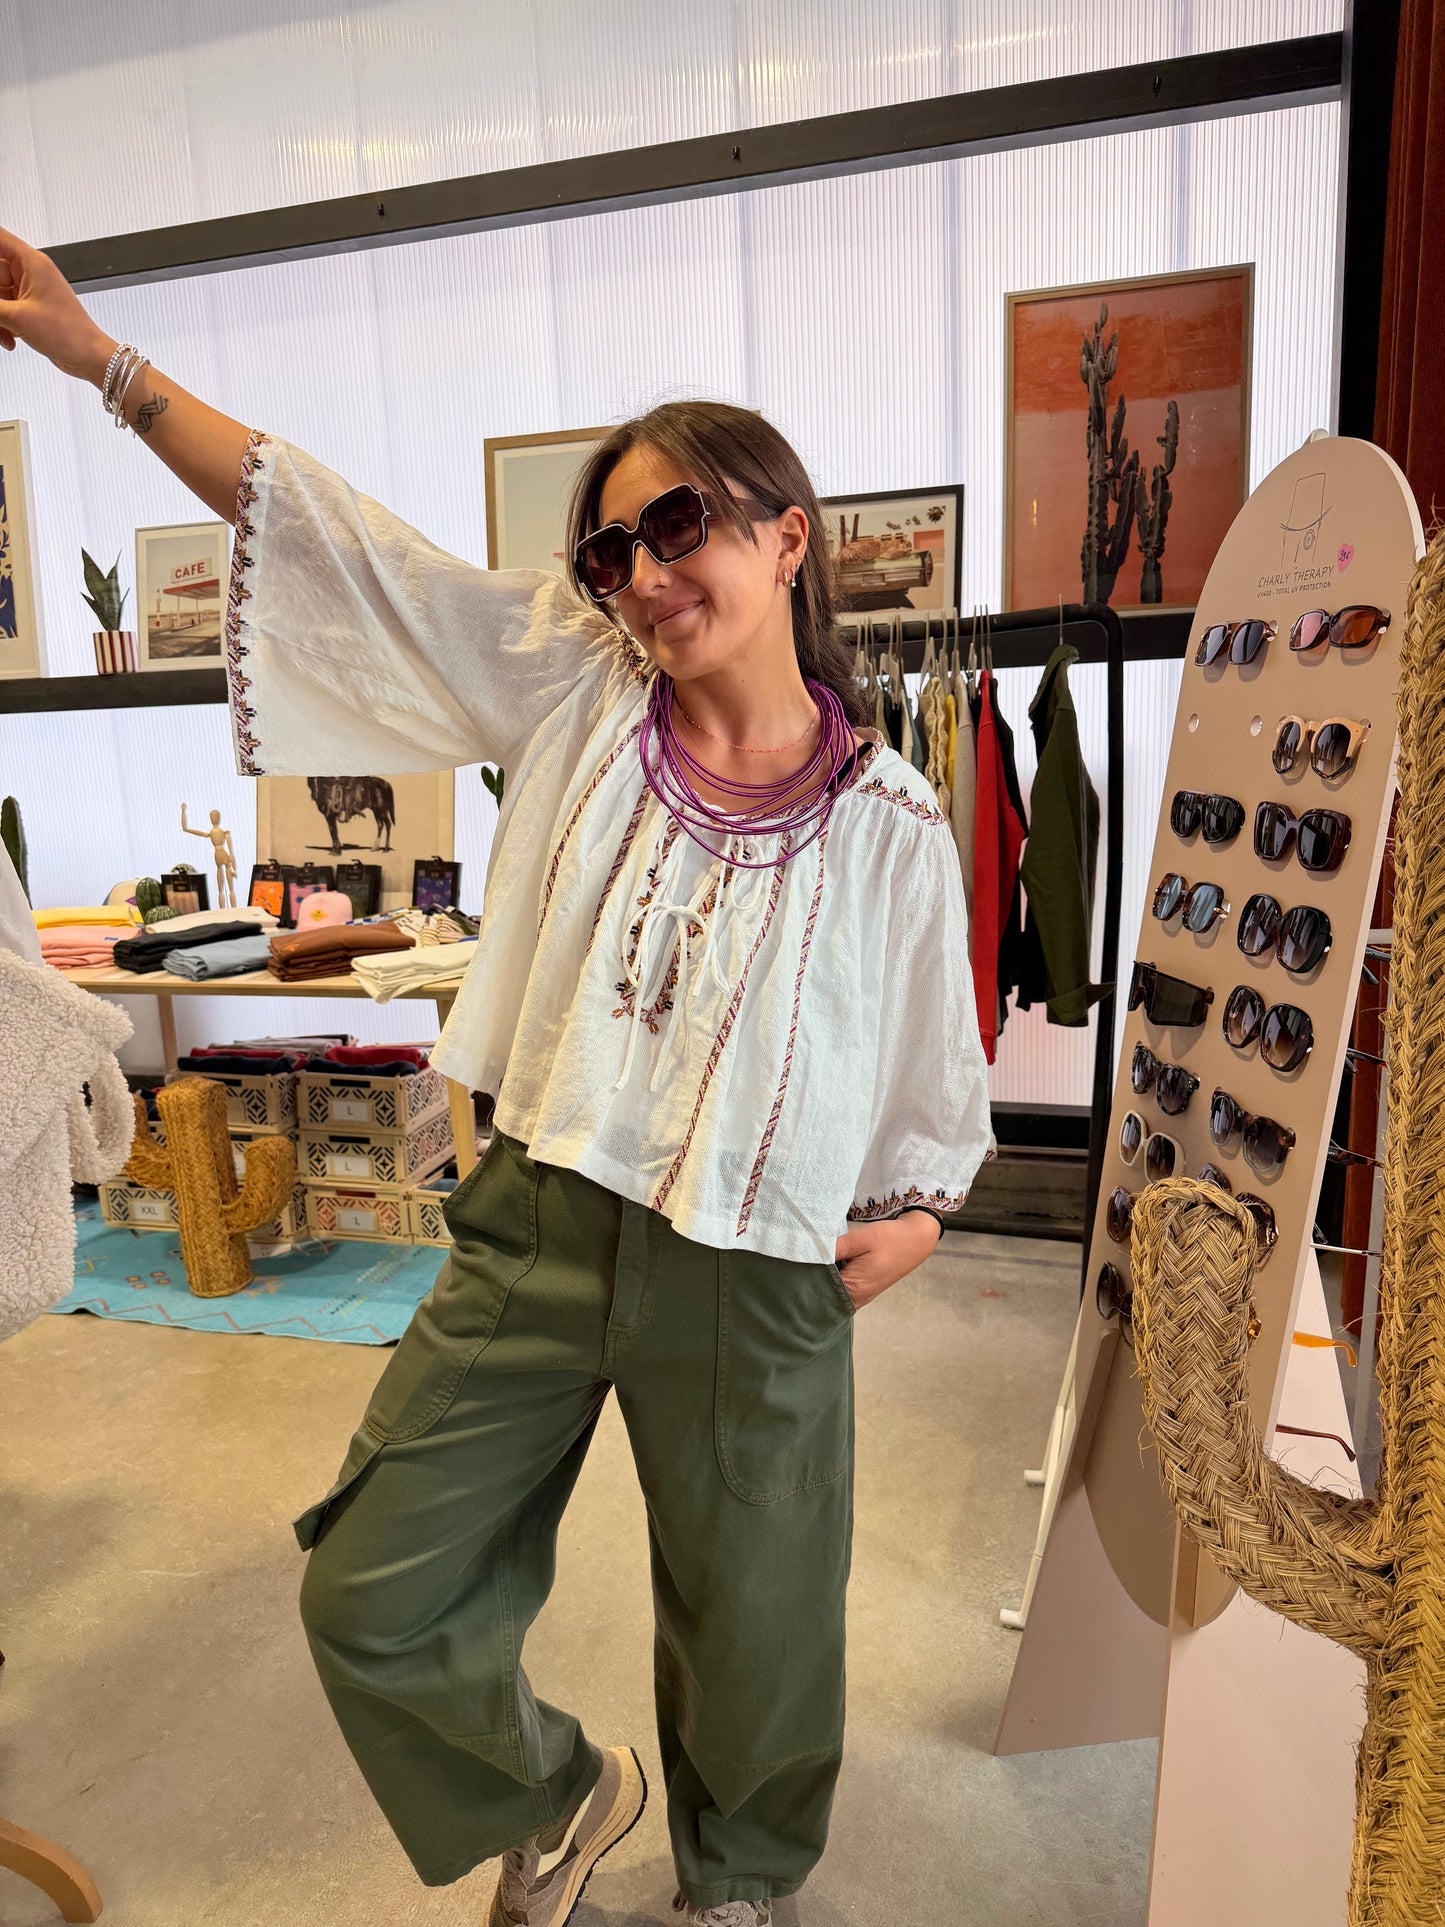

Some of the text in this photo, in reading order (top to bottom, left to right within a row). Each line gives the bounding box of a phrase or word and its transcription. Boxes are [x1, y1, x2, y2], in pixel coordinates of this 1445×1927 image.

[174, 561, 206, 579] CAFE
[1258, 565, 1335, 588] CHARLY THERAPY
[1276, 587, 1290, 595] TOTAL
[1299, 581, 1331, 592] PROTECTION
[347, 1104, 354, 1116] L
[345, 1161, 351, 1172] L
[141, 1205, 160, 1216] XXL
[354, 1215, 361, 1226] L
